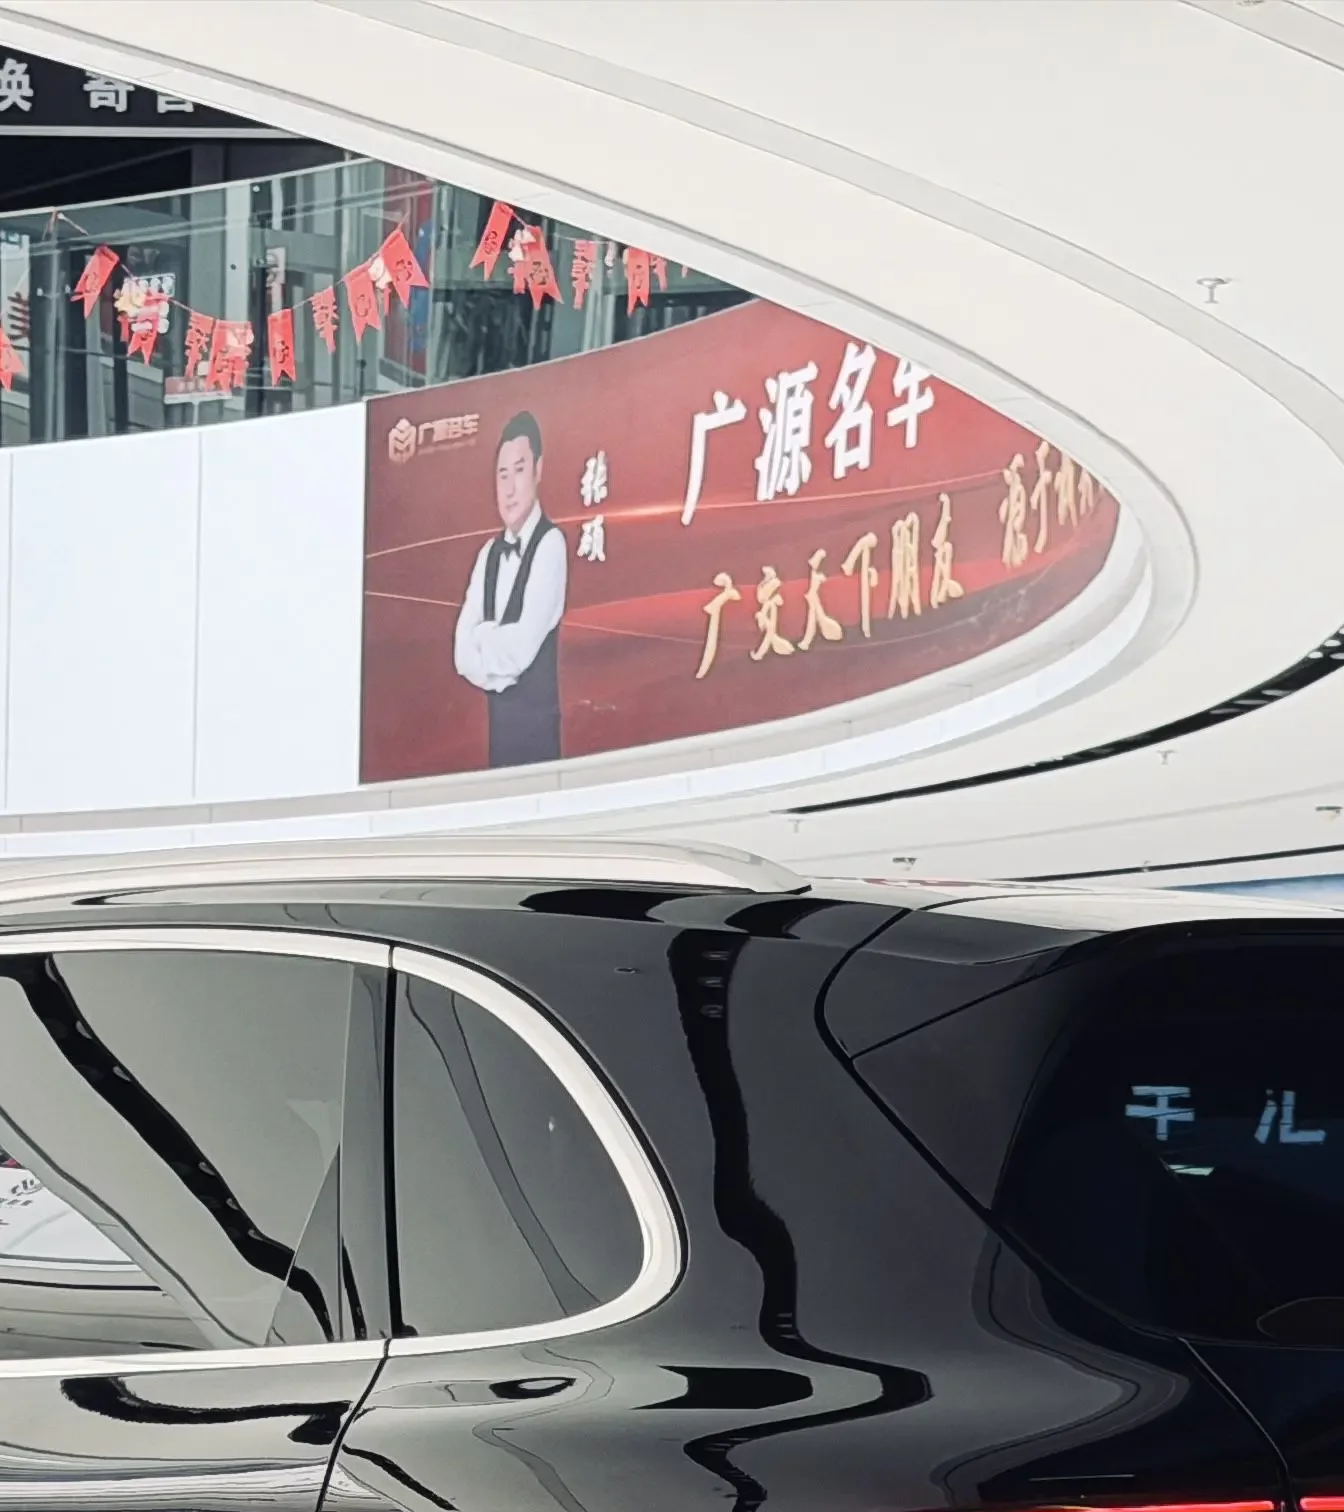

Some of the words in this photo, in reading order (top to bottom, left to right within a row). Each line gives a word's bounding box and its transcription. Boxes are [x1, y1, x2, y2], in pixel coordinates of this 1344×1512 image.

[681, 342, 934, 525] 广源名车
[696, 493, 964, 678] 广交天下朋友
